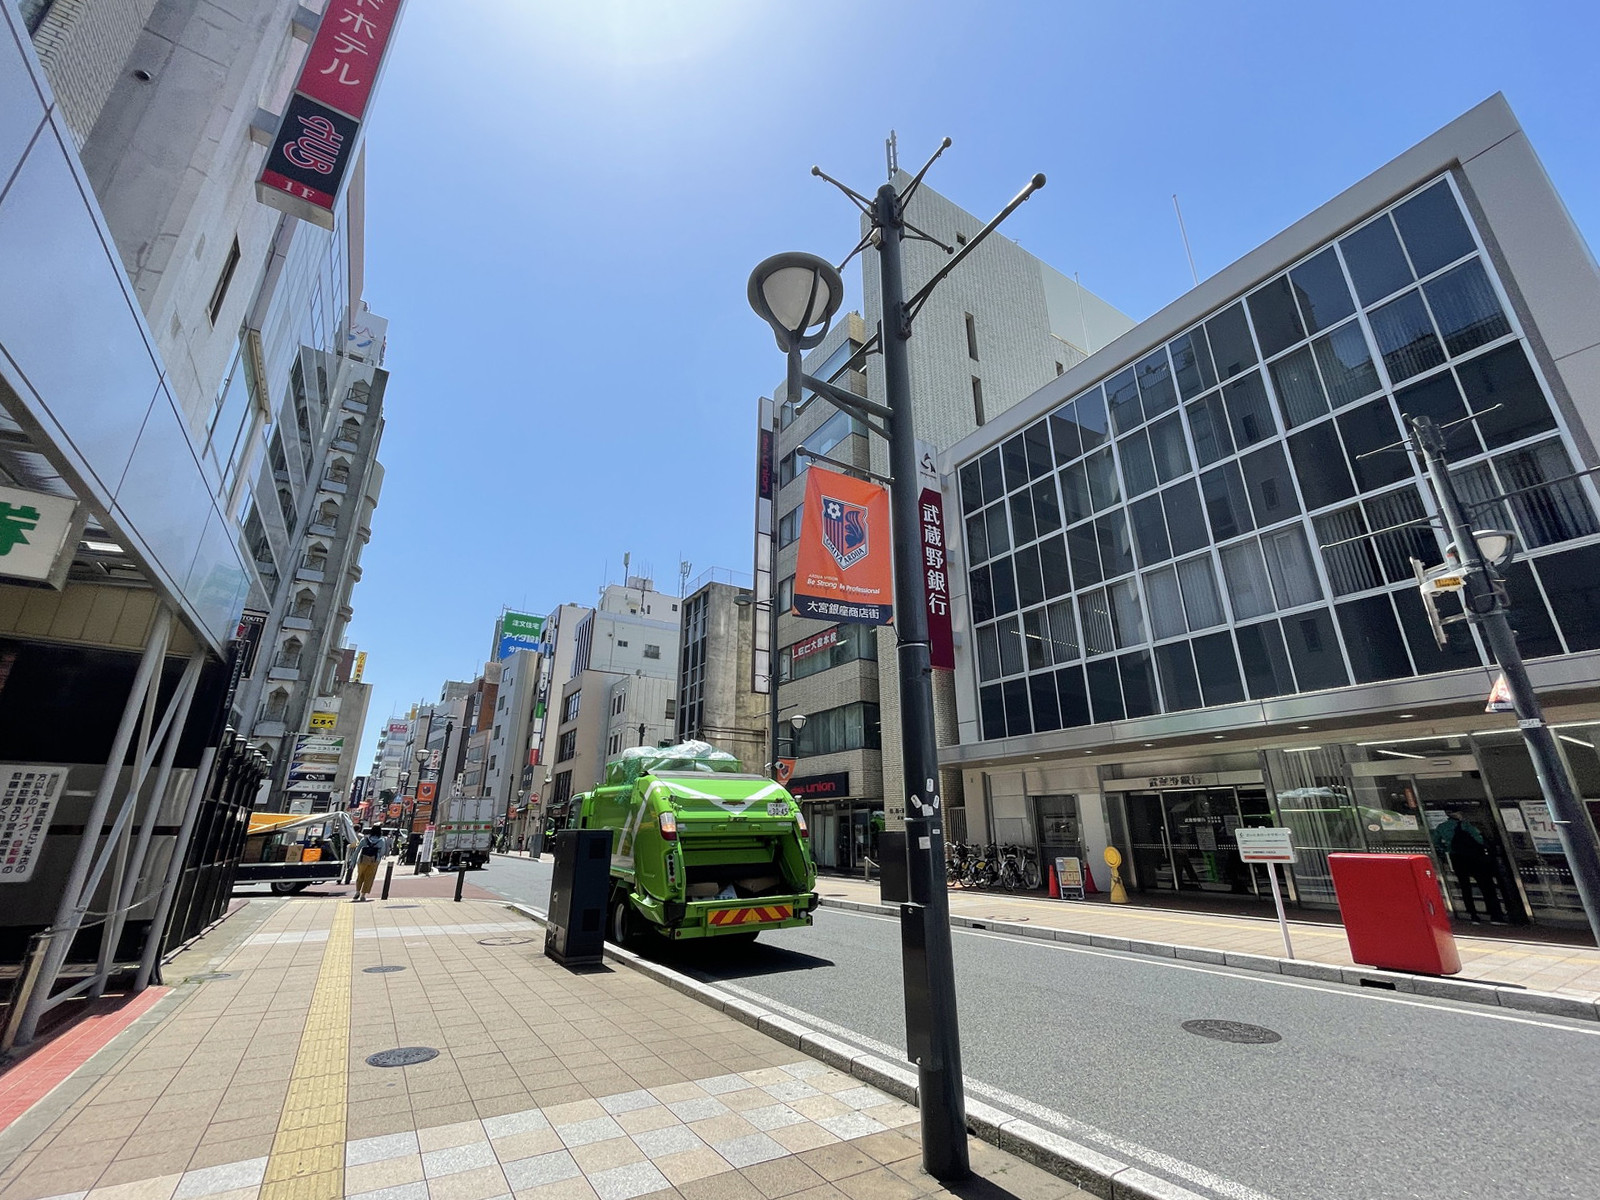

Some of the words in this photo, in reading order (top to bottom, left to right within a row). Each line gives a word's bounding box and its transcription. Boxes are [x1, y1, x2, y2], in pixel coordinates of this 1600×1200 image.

[922, 502, 948, 616] 武蔵野銀行
[816, 579, 838, 589] Strong
[846, 584, 881, 595] Professional
[807, 600, 880, 620] 大宮銀座商店街
[512, 619, 540, 630] 注文住宅
[806, 781, 837, 793] union
